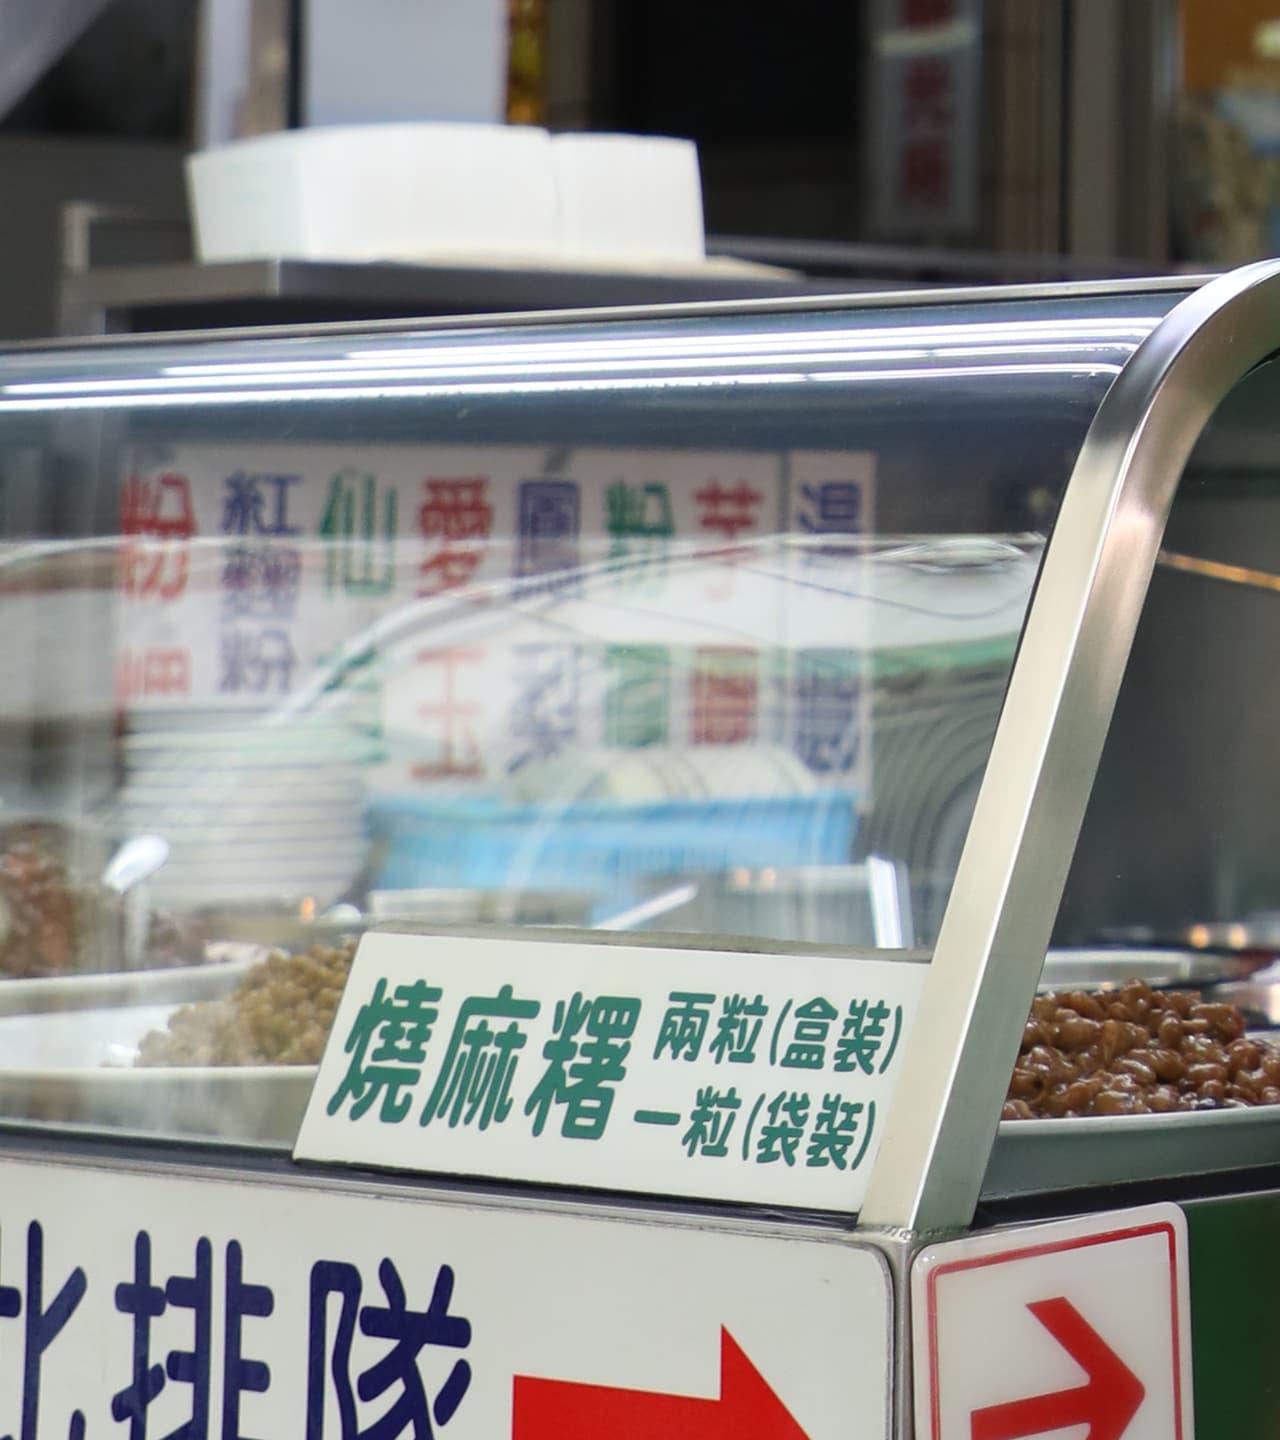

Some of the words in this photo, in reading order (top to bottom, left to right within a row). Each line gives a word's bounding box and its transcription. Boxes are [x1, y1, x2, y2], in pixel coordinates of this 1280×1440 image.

[326, 976, 642, 1141] 燒麻糬
[653, 991, 903, 1075] 兩粒(盒裝)
[634, 1086, 876, 1170] 一粒(袋裝)
